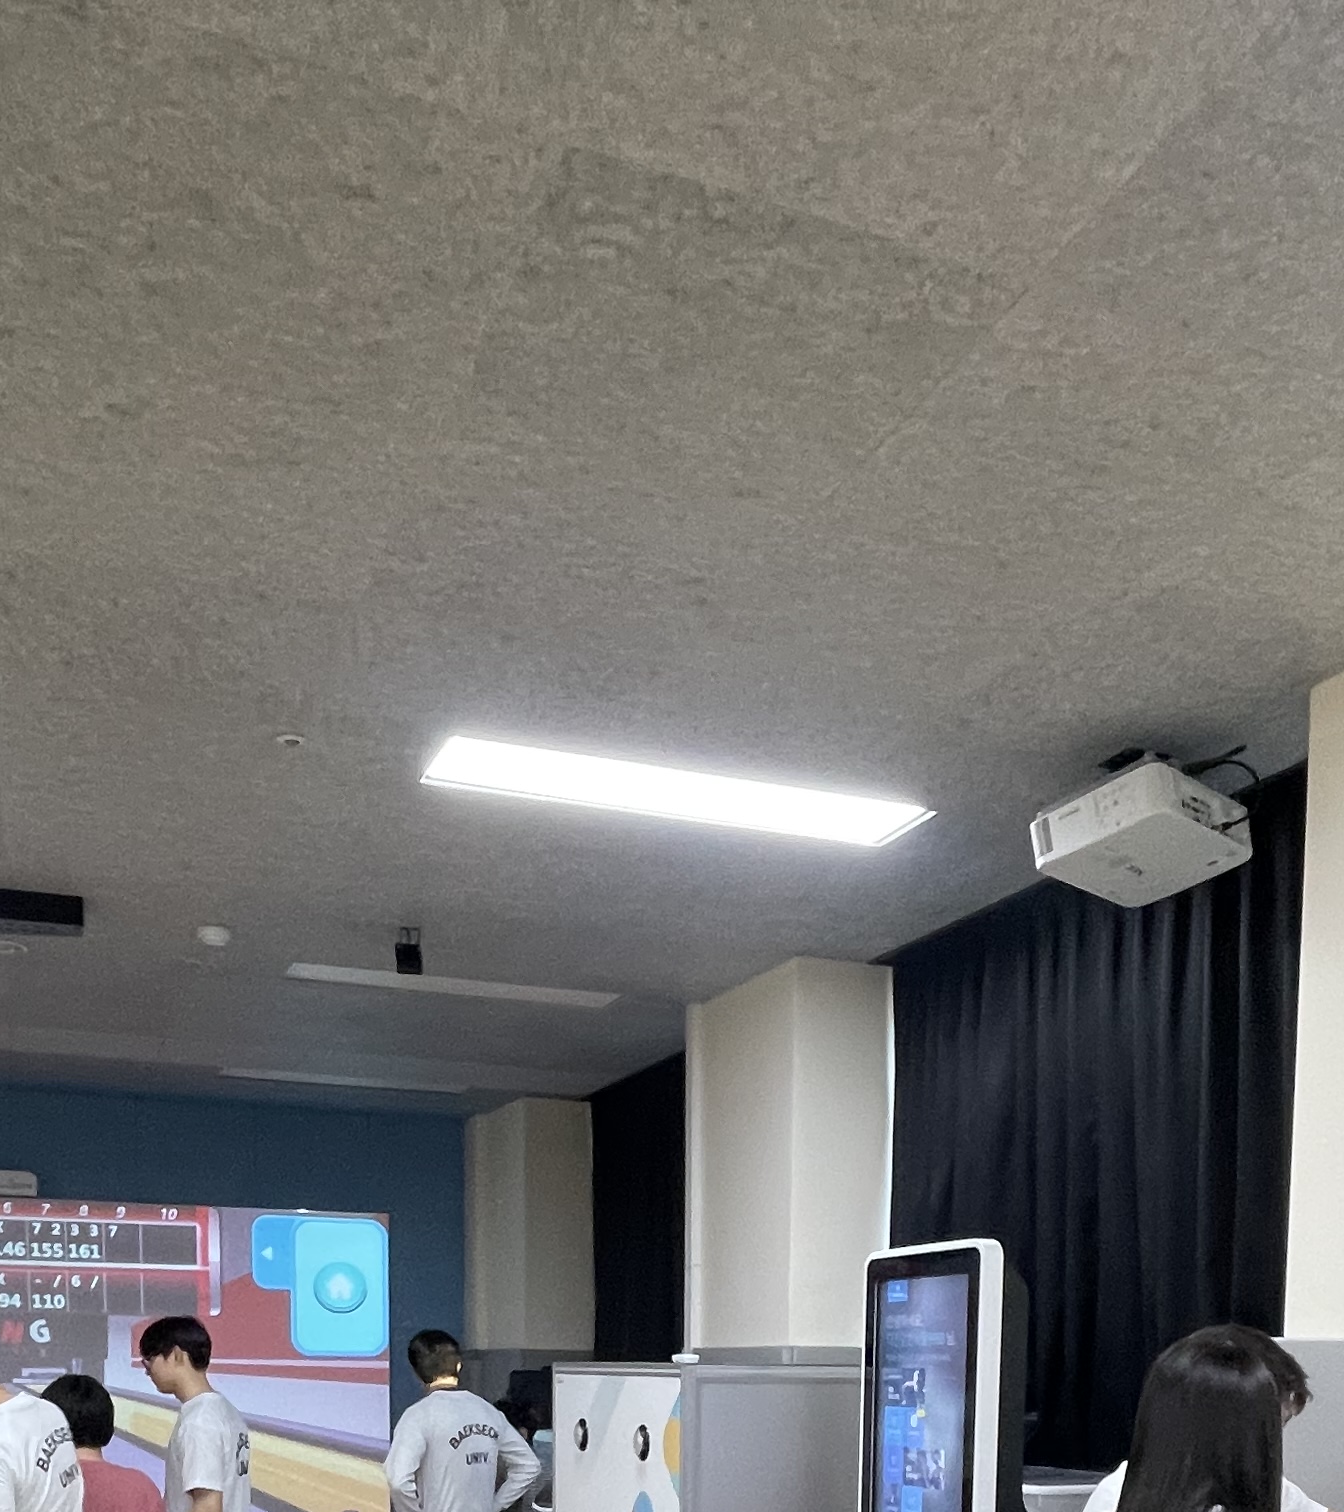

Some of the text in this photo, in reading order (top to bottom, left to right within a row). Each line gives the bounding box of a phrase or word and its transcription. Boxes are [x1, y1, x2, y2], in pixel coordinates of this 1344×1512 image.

[3, 1202, 12, 1214] 6
[41, 1203, 51, 1215] 7
[116, 1206, 126, 1219] 9
[160, 1207, 178, 1220] 10
[32, 1222, 41, 1235] 7
[51, 1223, 61, 1236] 2
[108, 1225, 118, 1238] 7
[30, 1242, 64, 1258] 155
[68, 1243, 101, 1259] 161
[71, 1275, 81, 1288] 6
[32, 1293, 66, 1309] 110
